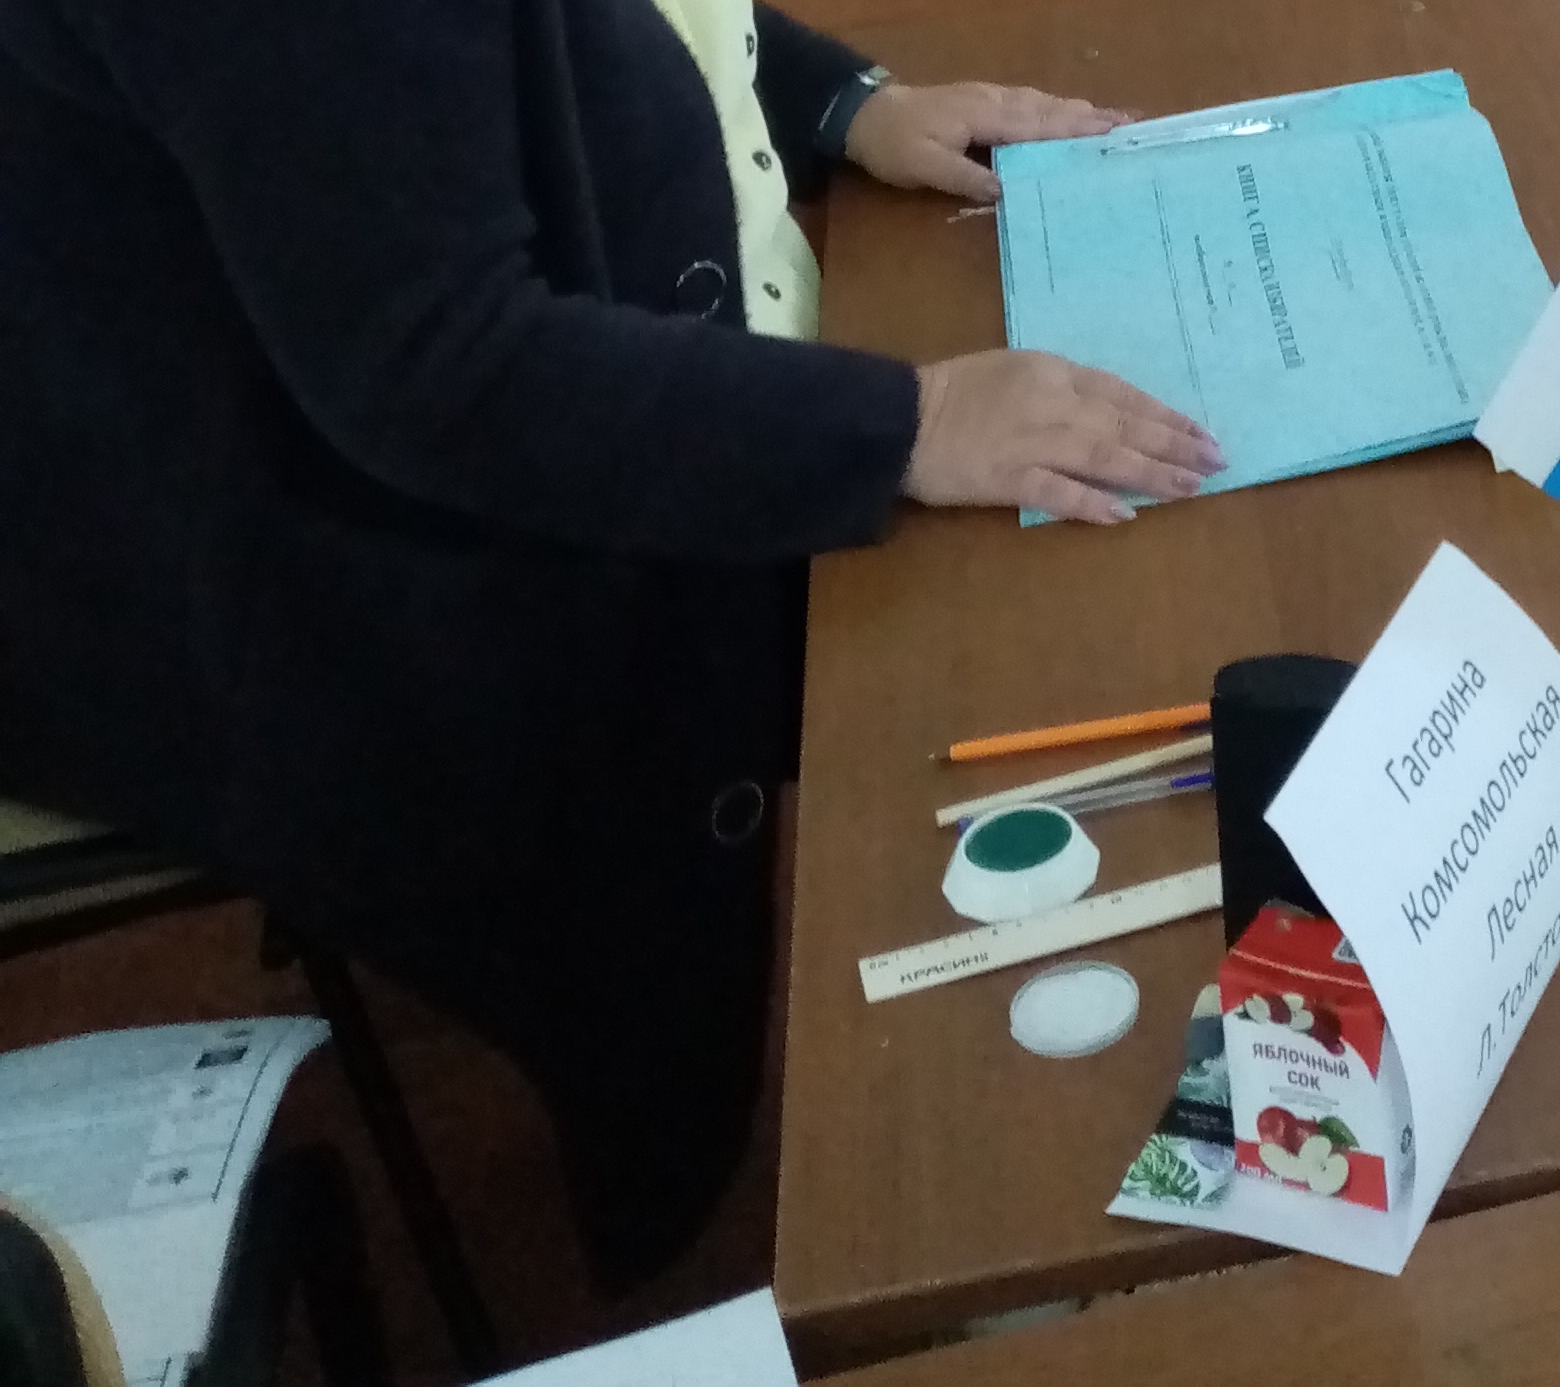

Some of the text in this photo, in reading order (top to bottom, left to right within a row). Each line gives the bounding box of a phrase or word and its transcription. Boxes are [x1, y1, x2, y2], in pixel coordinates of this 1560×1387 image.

[1384, 658, 1488, 805] Гагарина
[1486, 824, 1560, 963] Лесная
[1252, 1042, 1351, 1080] ЯБЛОЧНЫЙ
[1287, 1070, 1322, 1092] СОК
